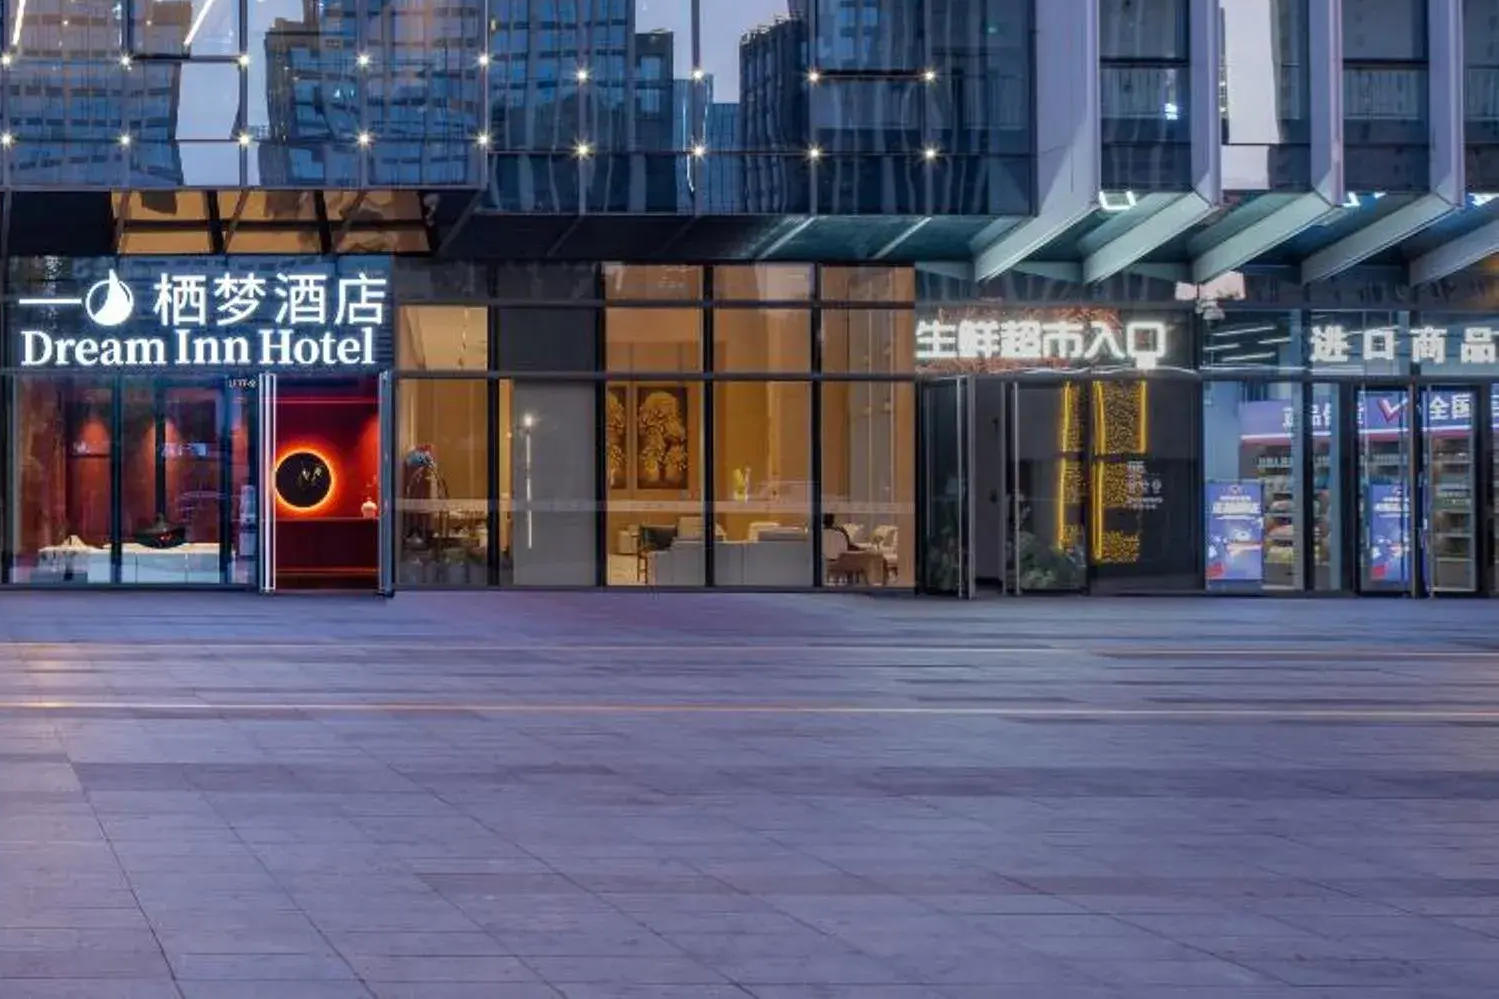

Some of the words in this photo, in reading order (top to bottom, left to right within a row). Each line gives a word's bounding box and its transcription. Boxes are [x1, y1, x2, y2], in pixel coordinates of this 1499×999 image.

[154, 272, 388, 326] 栖梦酒店
[20, 329, 167, 366] Dream
[174, 329, 251, 365] Inn
[257, 326, 376, 365] Hotel
[915, 319, 1167, 359] 生鲜超市入口
[1309, 325, 1497, 364] 进口商品
